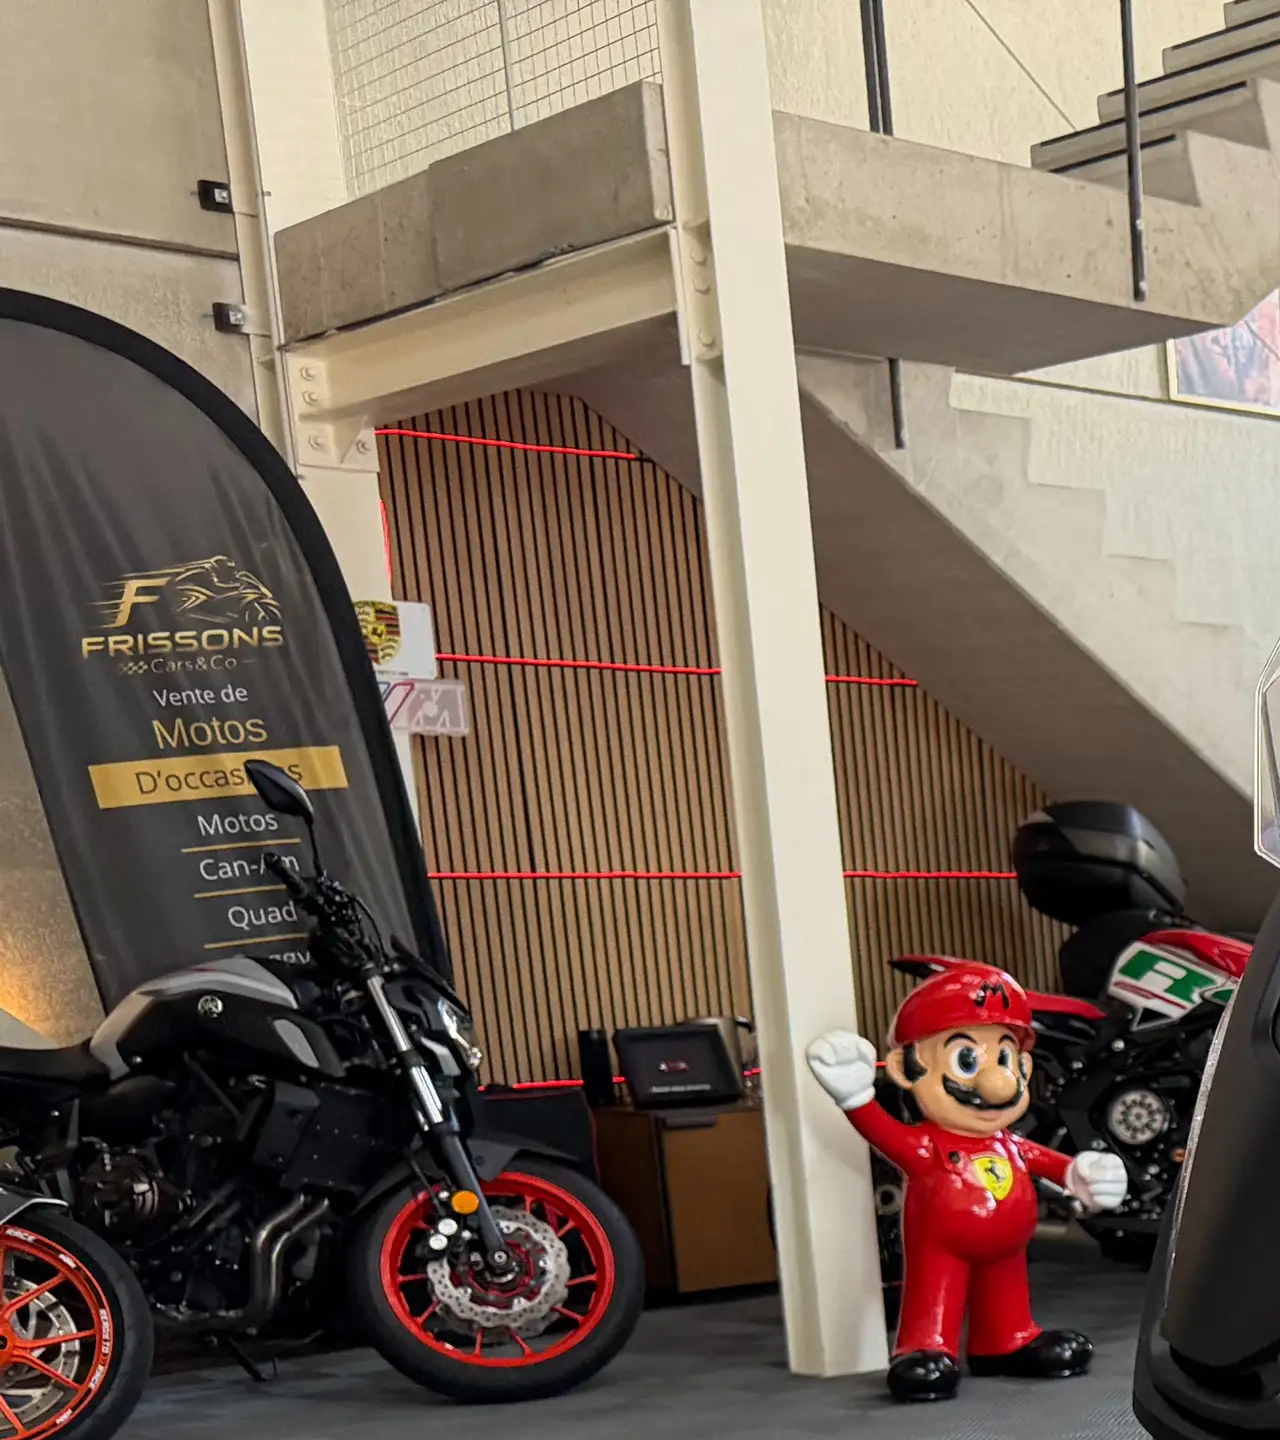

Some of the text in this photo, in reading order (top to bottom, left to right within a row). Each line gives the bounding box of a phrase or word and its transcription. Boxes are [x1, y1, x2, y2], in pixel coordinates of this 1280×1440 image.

[81, 625, 284, 660] FRISSONS
[150, 655, 238, 674] Cars&Co
[153, 684, 249, 707] Vente de
[152, 716, 268, 750] Motos
[135, 764, 304, 795] D'occass
[197, 813, 279, 836] Motos
[228, 901, 298, 930] Quad
